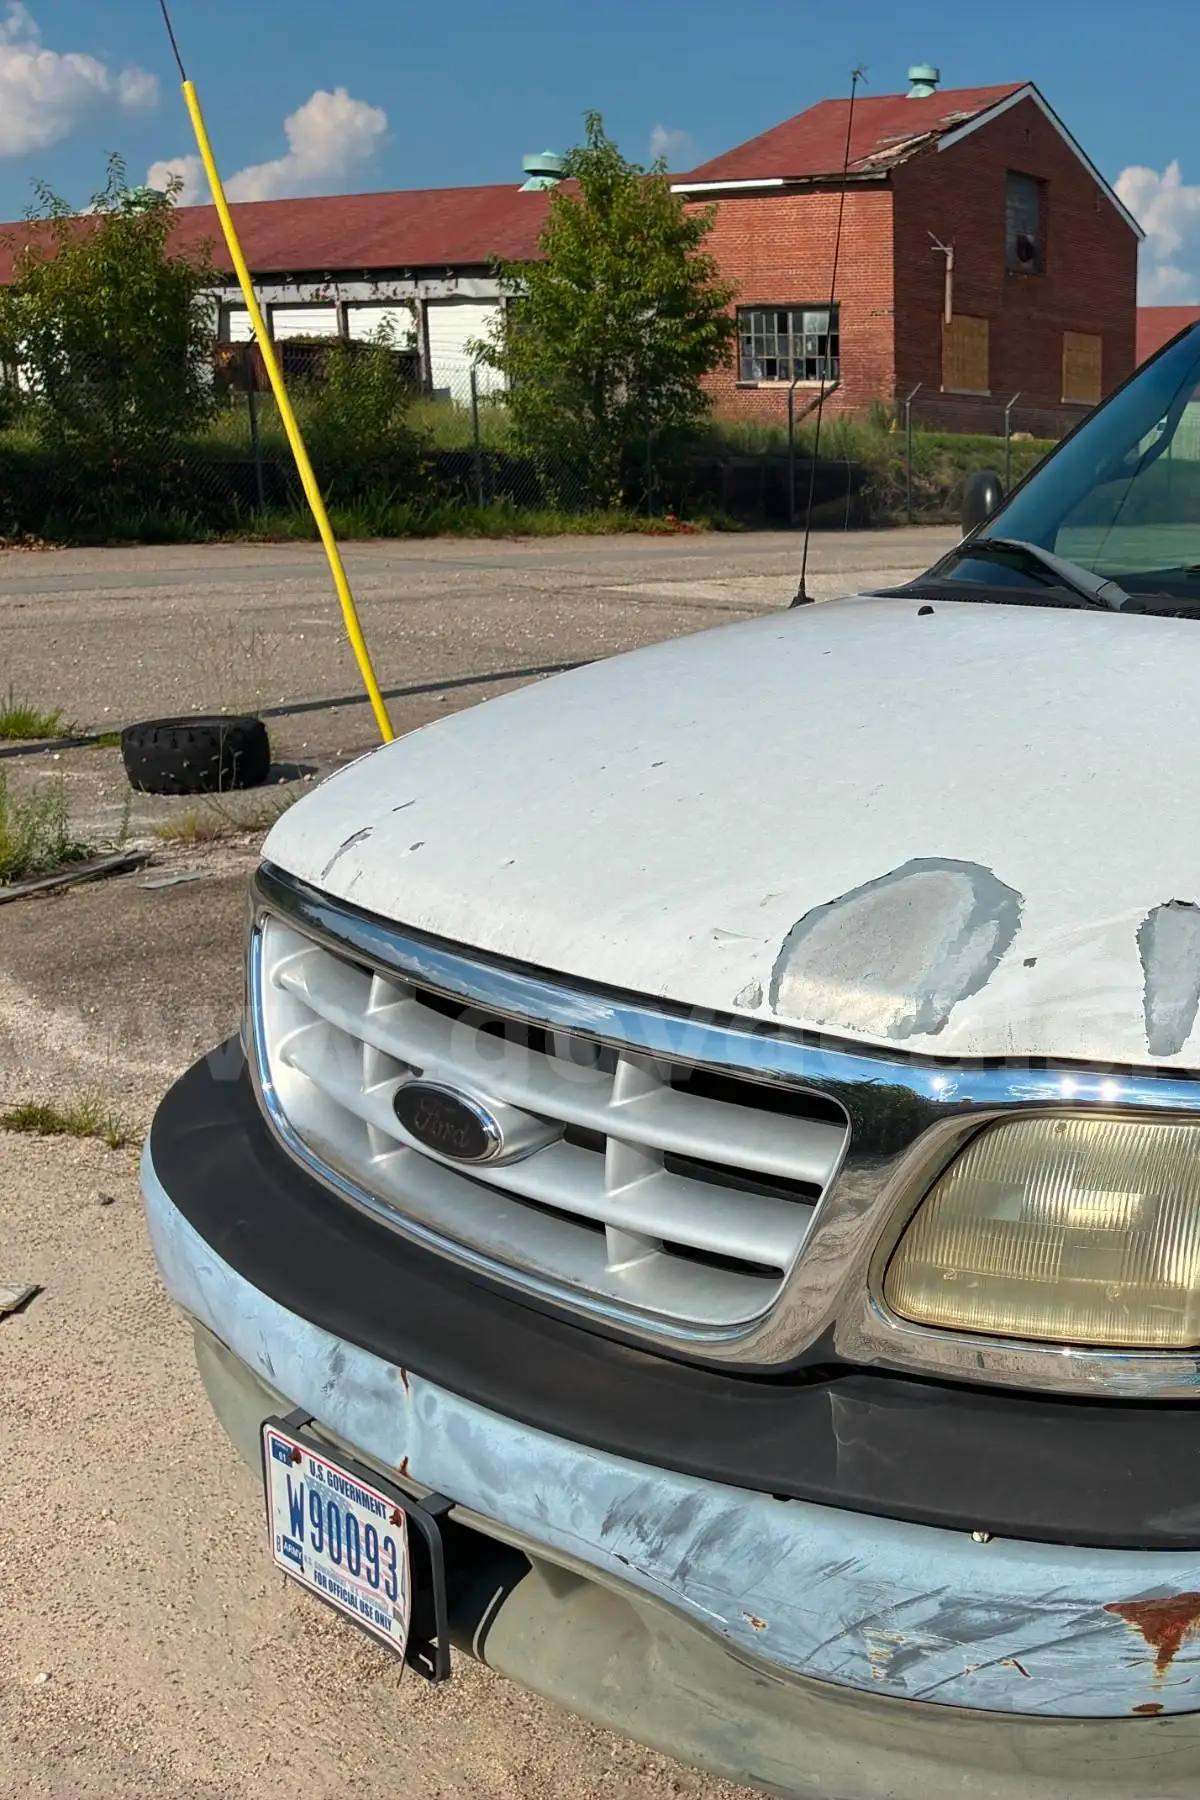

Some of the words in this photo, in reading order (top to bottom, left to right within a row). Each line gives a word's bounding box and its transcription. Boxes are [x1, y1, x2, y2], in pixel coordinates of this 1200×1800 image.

[309, 1459, 326, 1482] U.S.
[327, 1470, 387, 1520] GOVERNMENT
[286, 1473, 398, 1601] W90093
[314, 1569, 328, 1590] FOR
[328, 1579, 359, 1610] OFFICIAL
[360, 1599, 374, 1620] USE
[374, 1610, 392, 1632] ONLY
